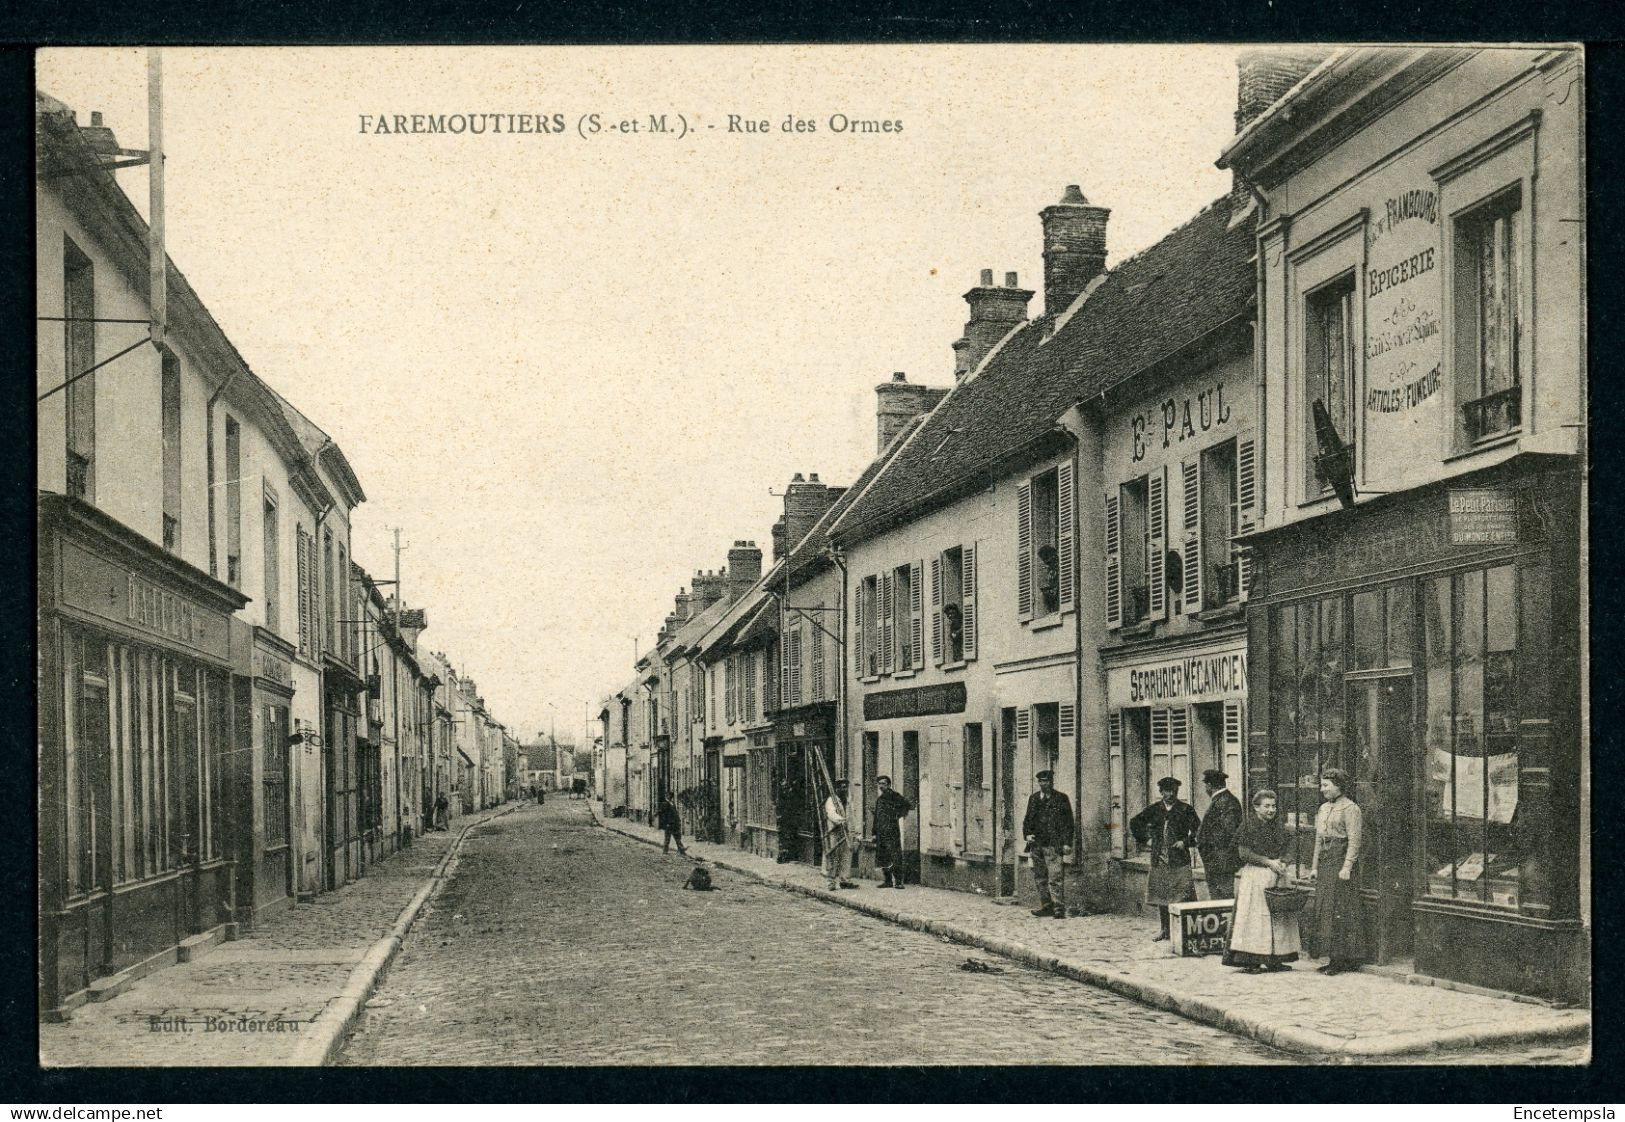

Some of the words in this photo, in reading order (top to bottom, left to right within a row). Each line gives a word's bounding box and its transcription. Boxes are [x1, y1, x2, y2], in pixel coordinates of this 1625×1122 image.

[1368, 247, 1435, 299] EPICERIE
[1160, 381, 1231, 450] PAUL
[1366, 386, 1400, 414] ARTICLES
[1130, 664, 1182, 702] SERRURIER
